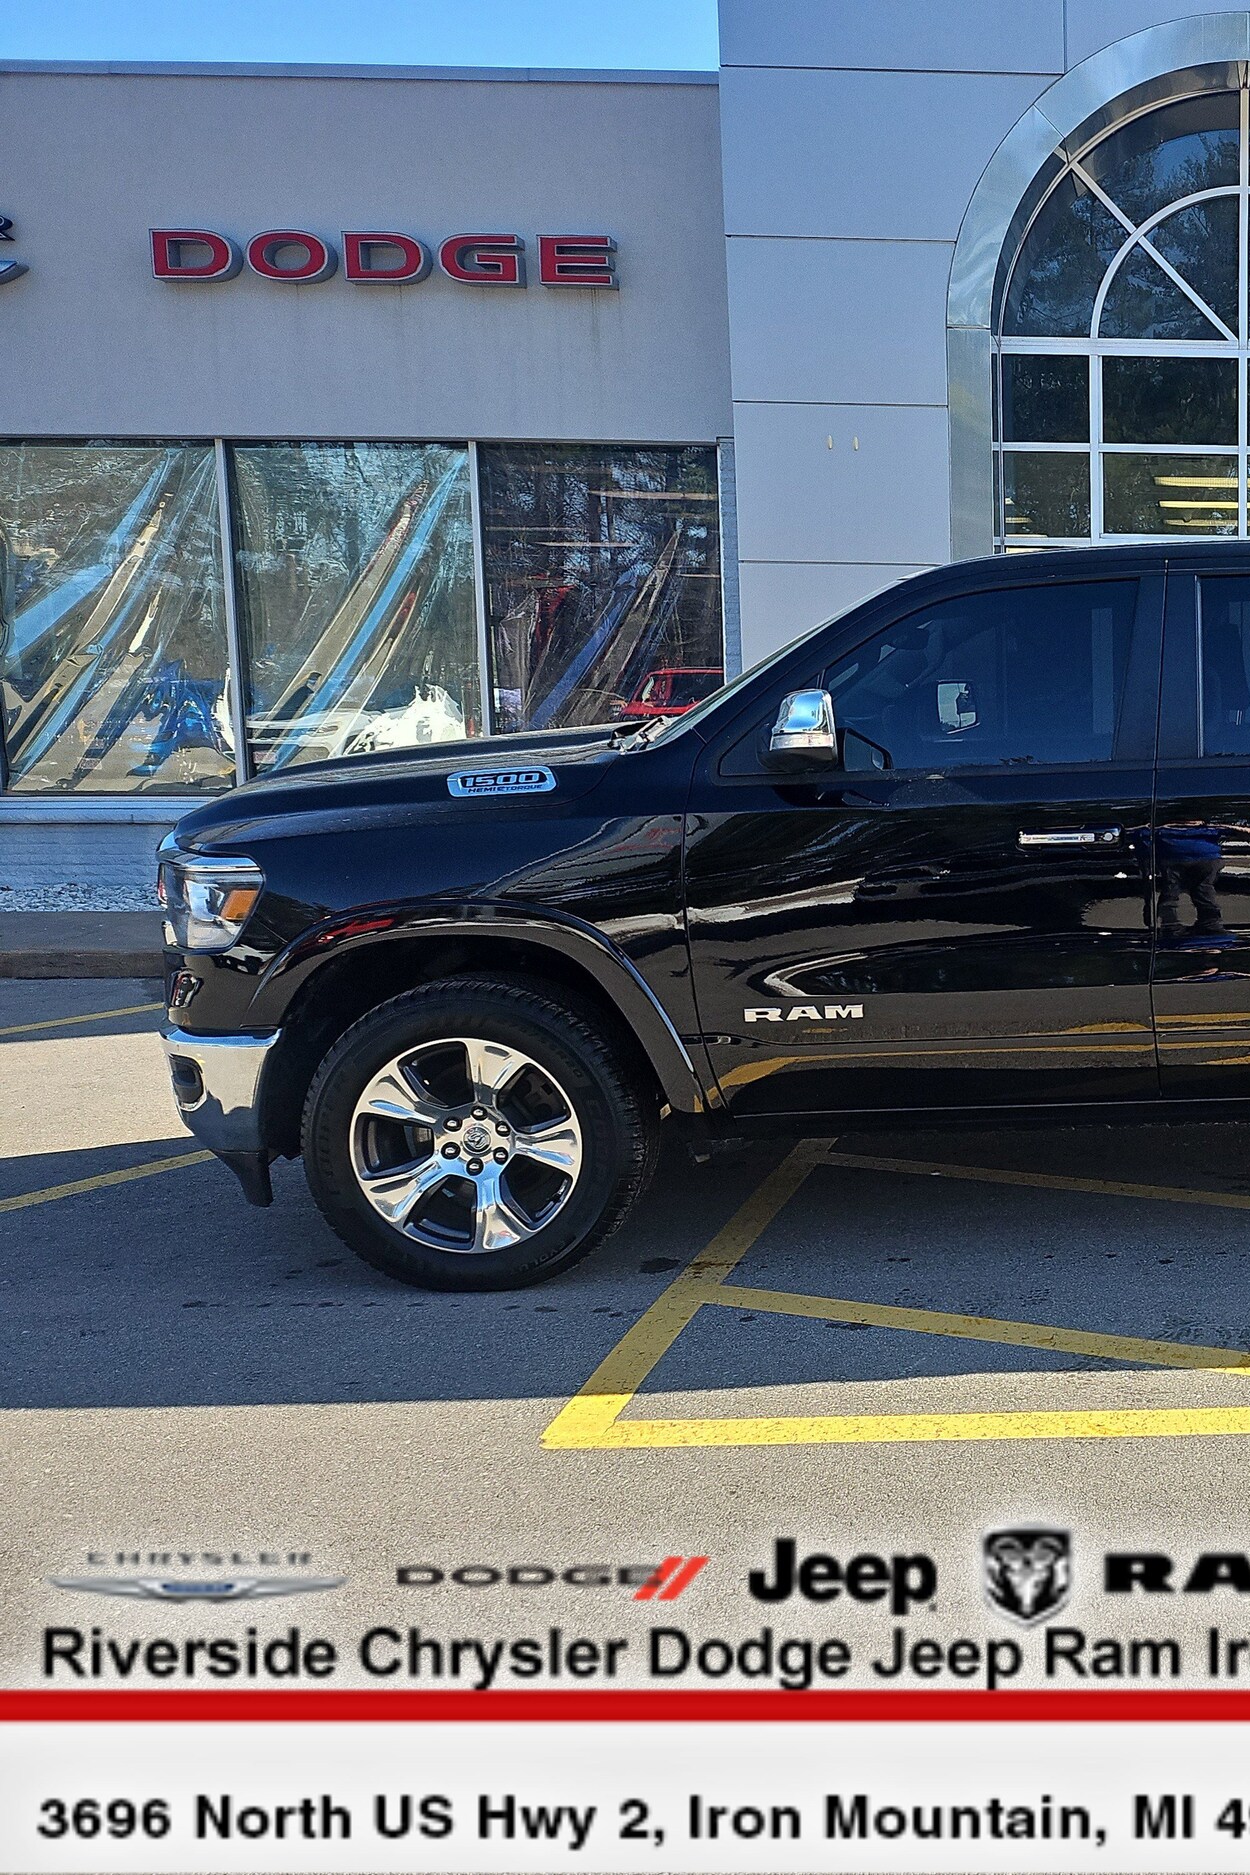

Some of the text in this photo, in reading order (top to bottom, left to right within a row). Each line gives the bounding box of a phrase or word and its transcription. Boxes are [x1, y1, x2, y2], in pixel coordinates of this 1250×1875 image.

[149, 228, 618, 290] DODGE
[465, 772, 540, 787] 1500
[467, 786, 497, 794] HEMI
[743, 1003, 864, 1022] RAM
